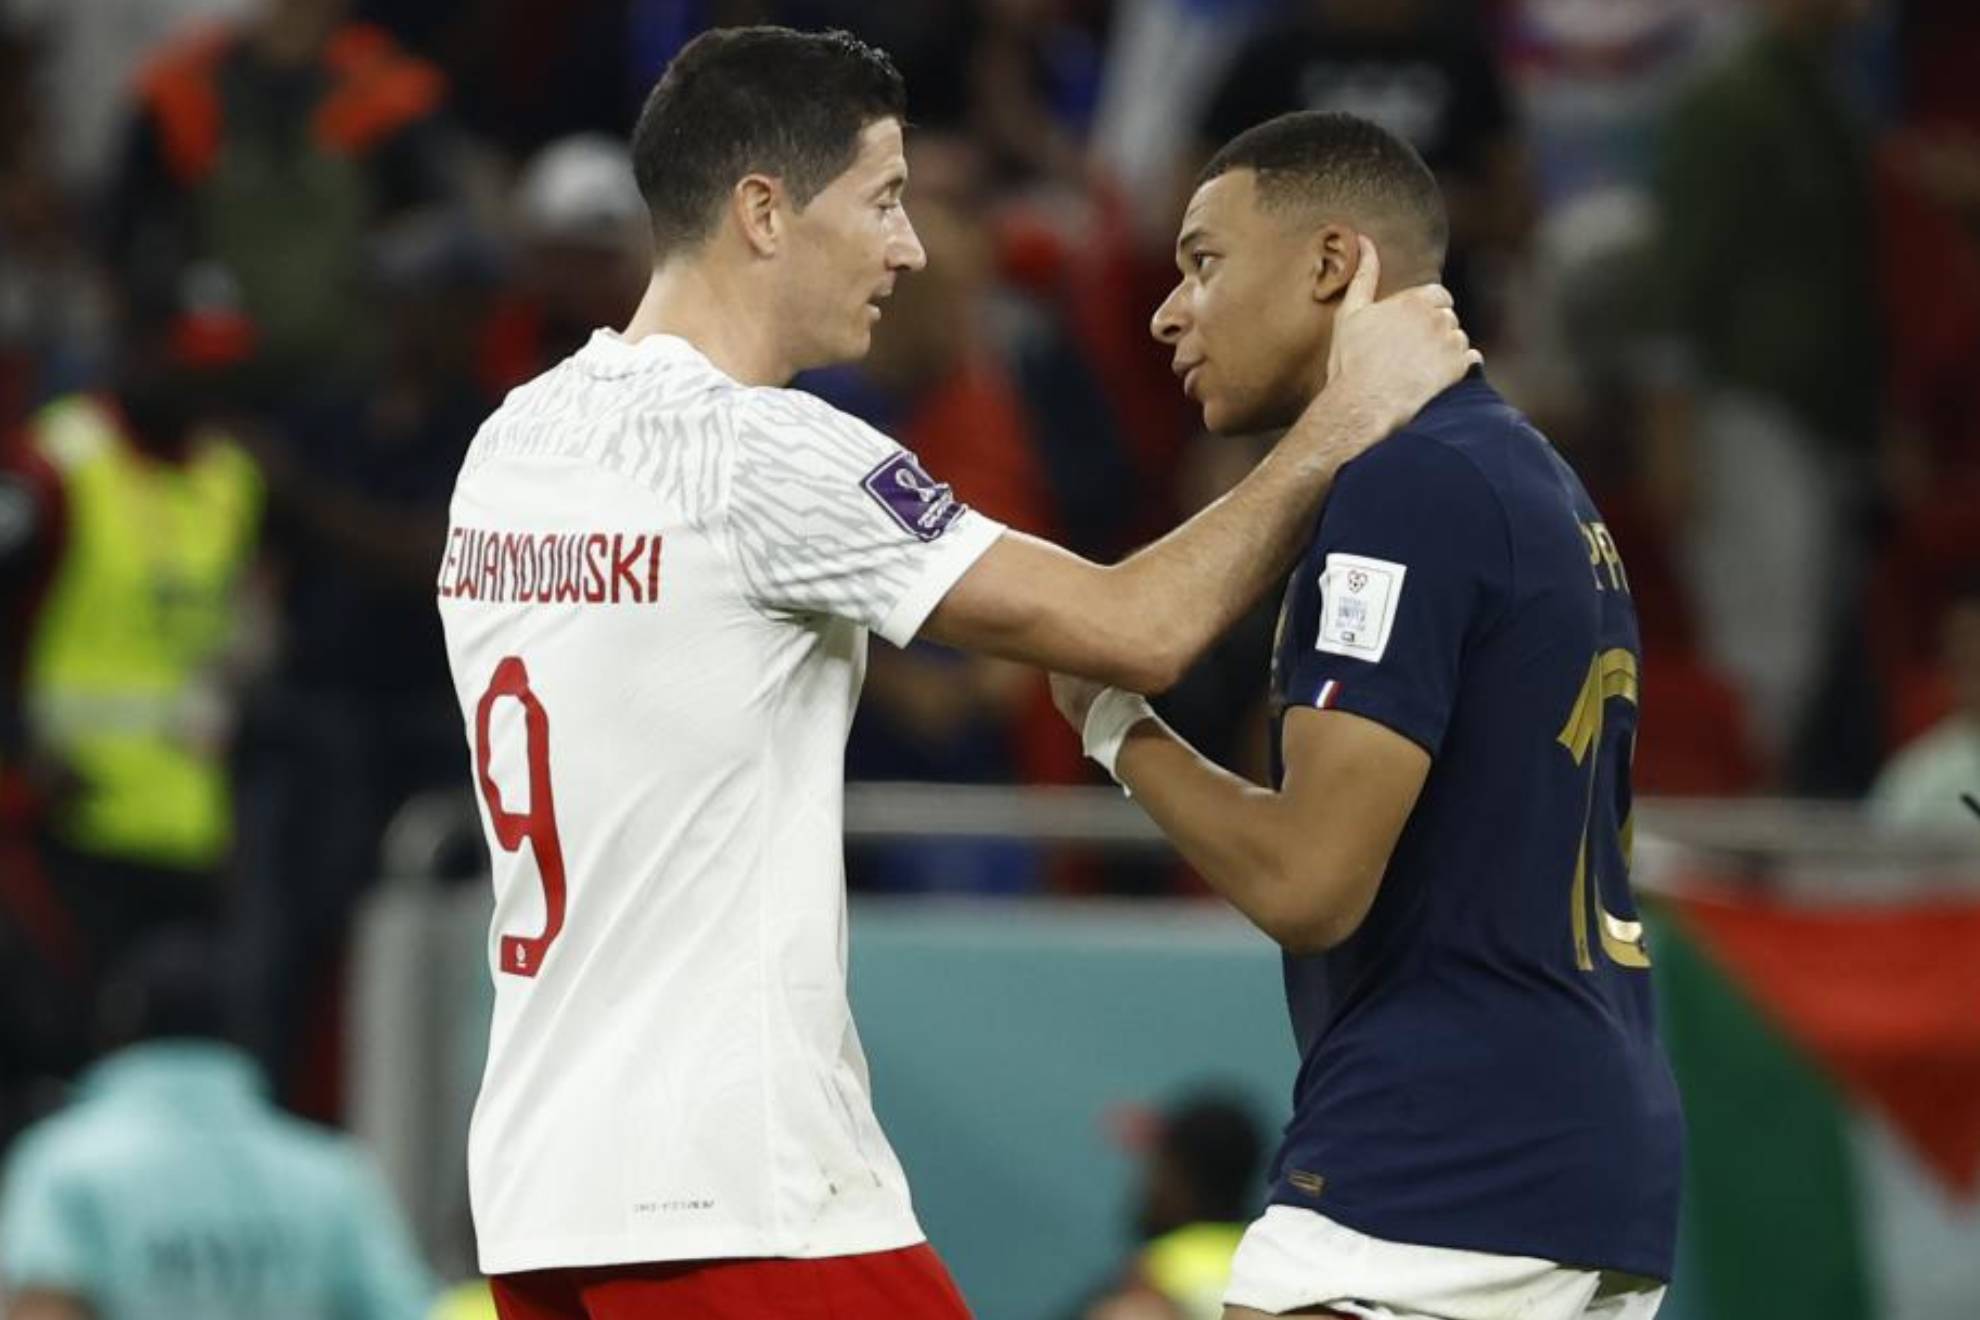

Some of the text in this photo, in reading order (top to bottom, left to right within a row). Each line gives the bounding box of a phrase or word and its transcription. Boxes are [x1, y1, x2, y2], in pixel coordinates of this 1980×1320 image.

[438, 527, 662, 603] EWANDOWSKI
[475, 656, 567, 977] 9
[1556, 647, 1651, 970] 10
